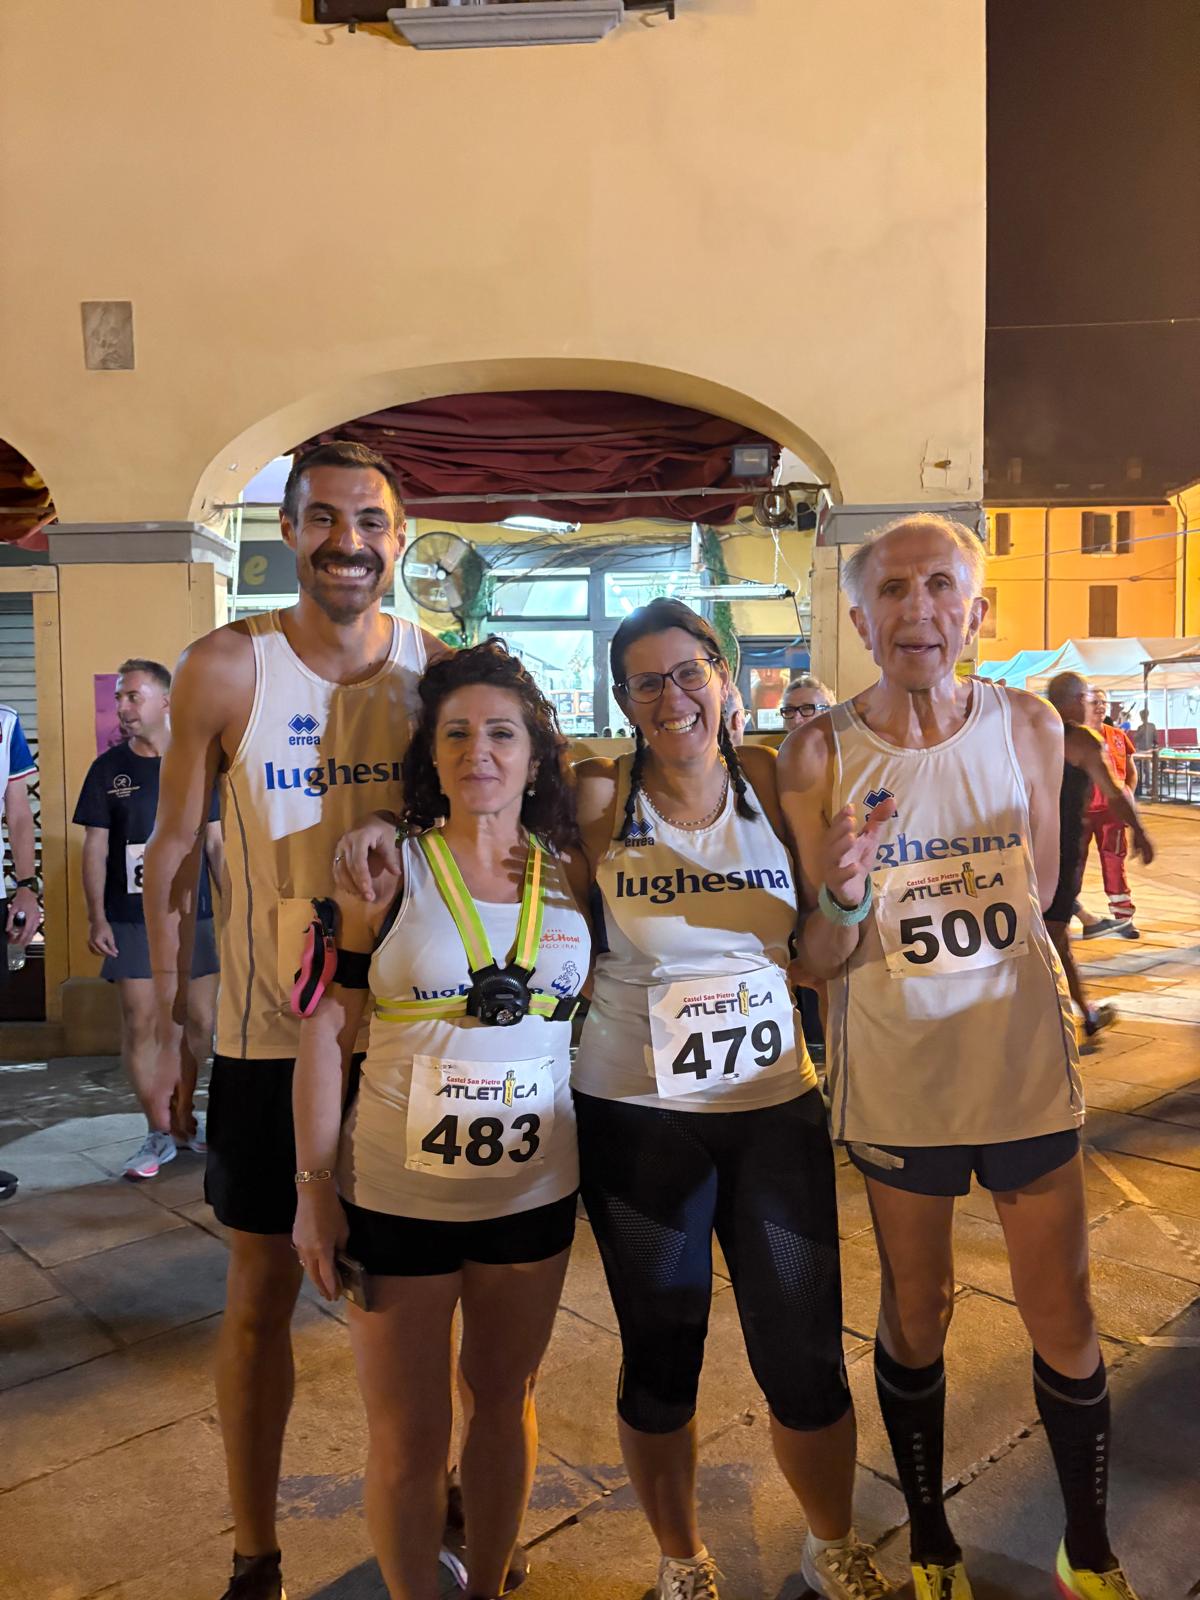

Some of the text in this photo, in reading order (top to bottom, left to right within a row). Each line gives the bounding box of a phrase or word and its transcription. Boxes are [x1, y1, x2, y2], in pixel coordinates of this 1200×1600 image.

[288, 735, 321, 746] errea
[265, 758, 405, 797] lughesi
[624, 836, 655, 848] errea
[616, 868, 790, 904] lughesina
[900, 902, 1017, 965] 500
[672, 1019, 782, 1080] 479
[446, 1076, 466, 1084] Castel
[421, 1113, 541, 1167] 483
